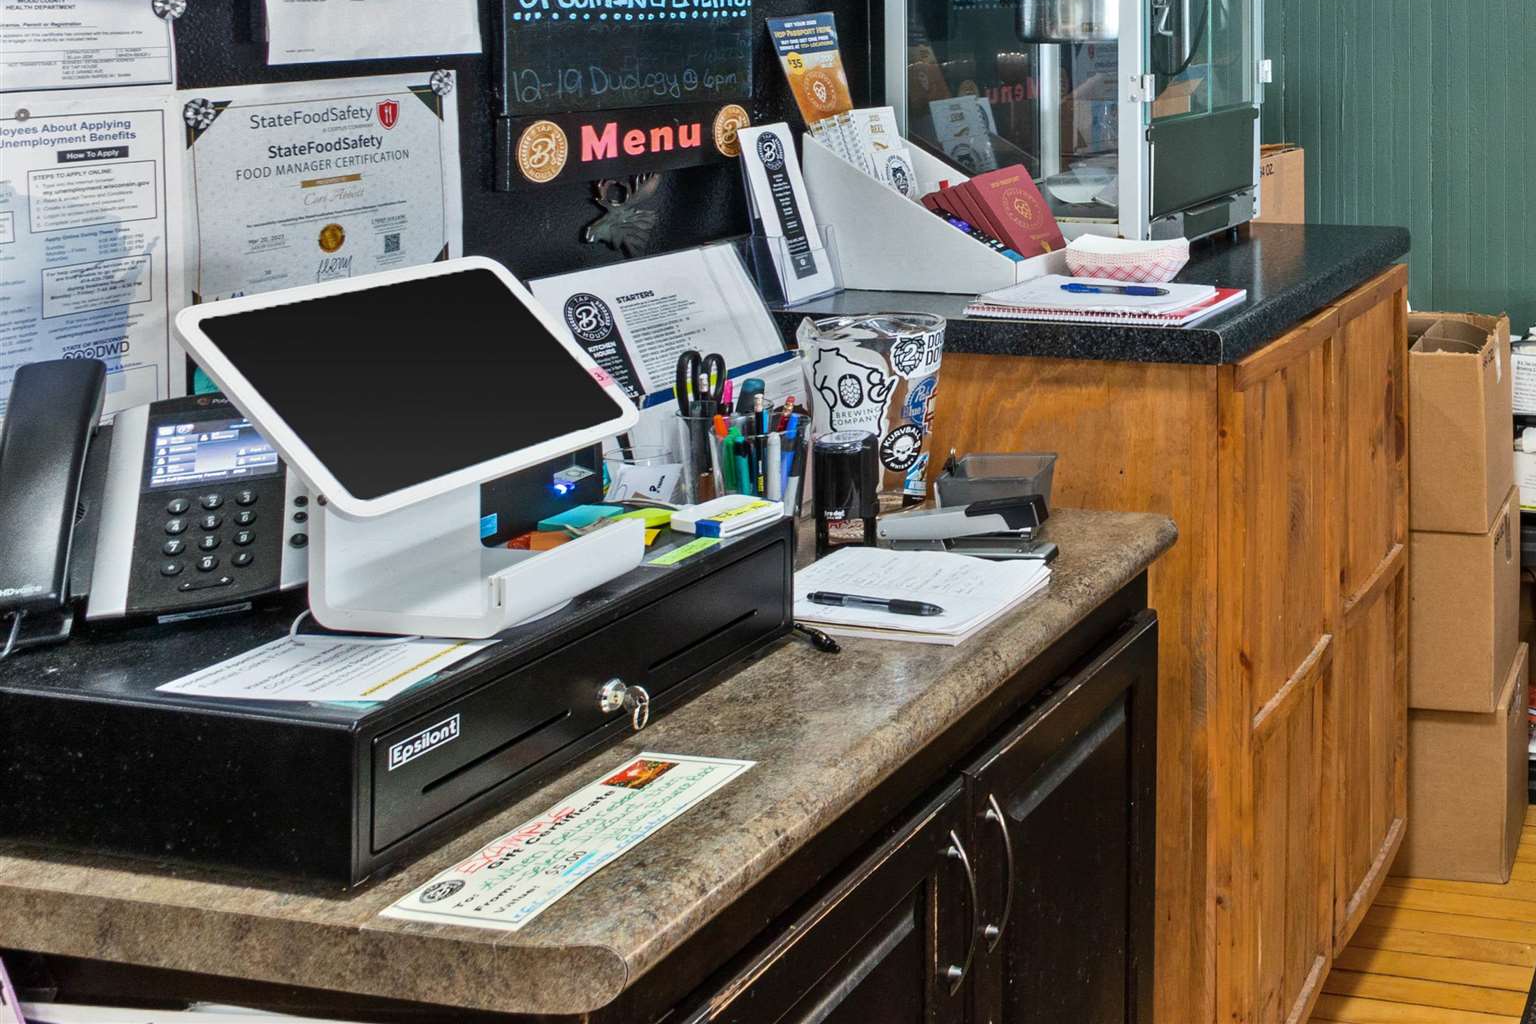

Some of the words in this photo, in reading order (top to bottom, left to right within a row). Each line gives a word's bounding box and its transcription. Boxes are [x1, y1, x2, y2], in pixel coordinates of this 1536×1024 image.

[41, 123, 77, 134] About
[80, 119, 131, 134] Applying
[250, 106, 374, 129] StateFoodSafety
[90, 131, 136, 143] Benefits
[268, 134, 383, 159] StateFoodSafety
[580, 122, 701, 162] Menu
[67, 151, 85, 160] How
[97, 149, 119, 159] Apply
[236, 166, 271, 181] FOOD
[275, 159, 332, 176] MANAGER
[335, 149, 410, 168] CERTIFICATION
[616, 290, 655, 304] STARTERS
[96, 340, 130, 358] DWD
[392, 719, 457, 765] Epsilont
[487, 847, 524, 871] Gift
[524, 790, 616, 846] Certificate
